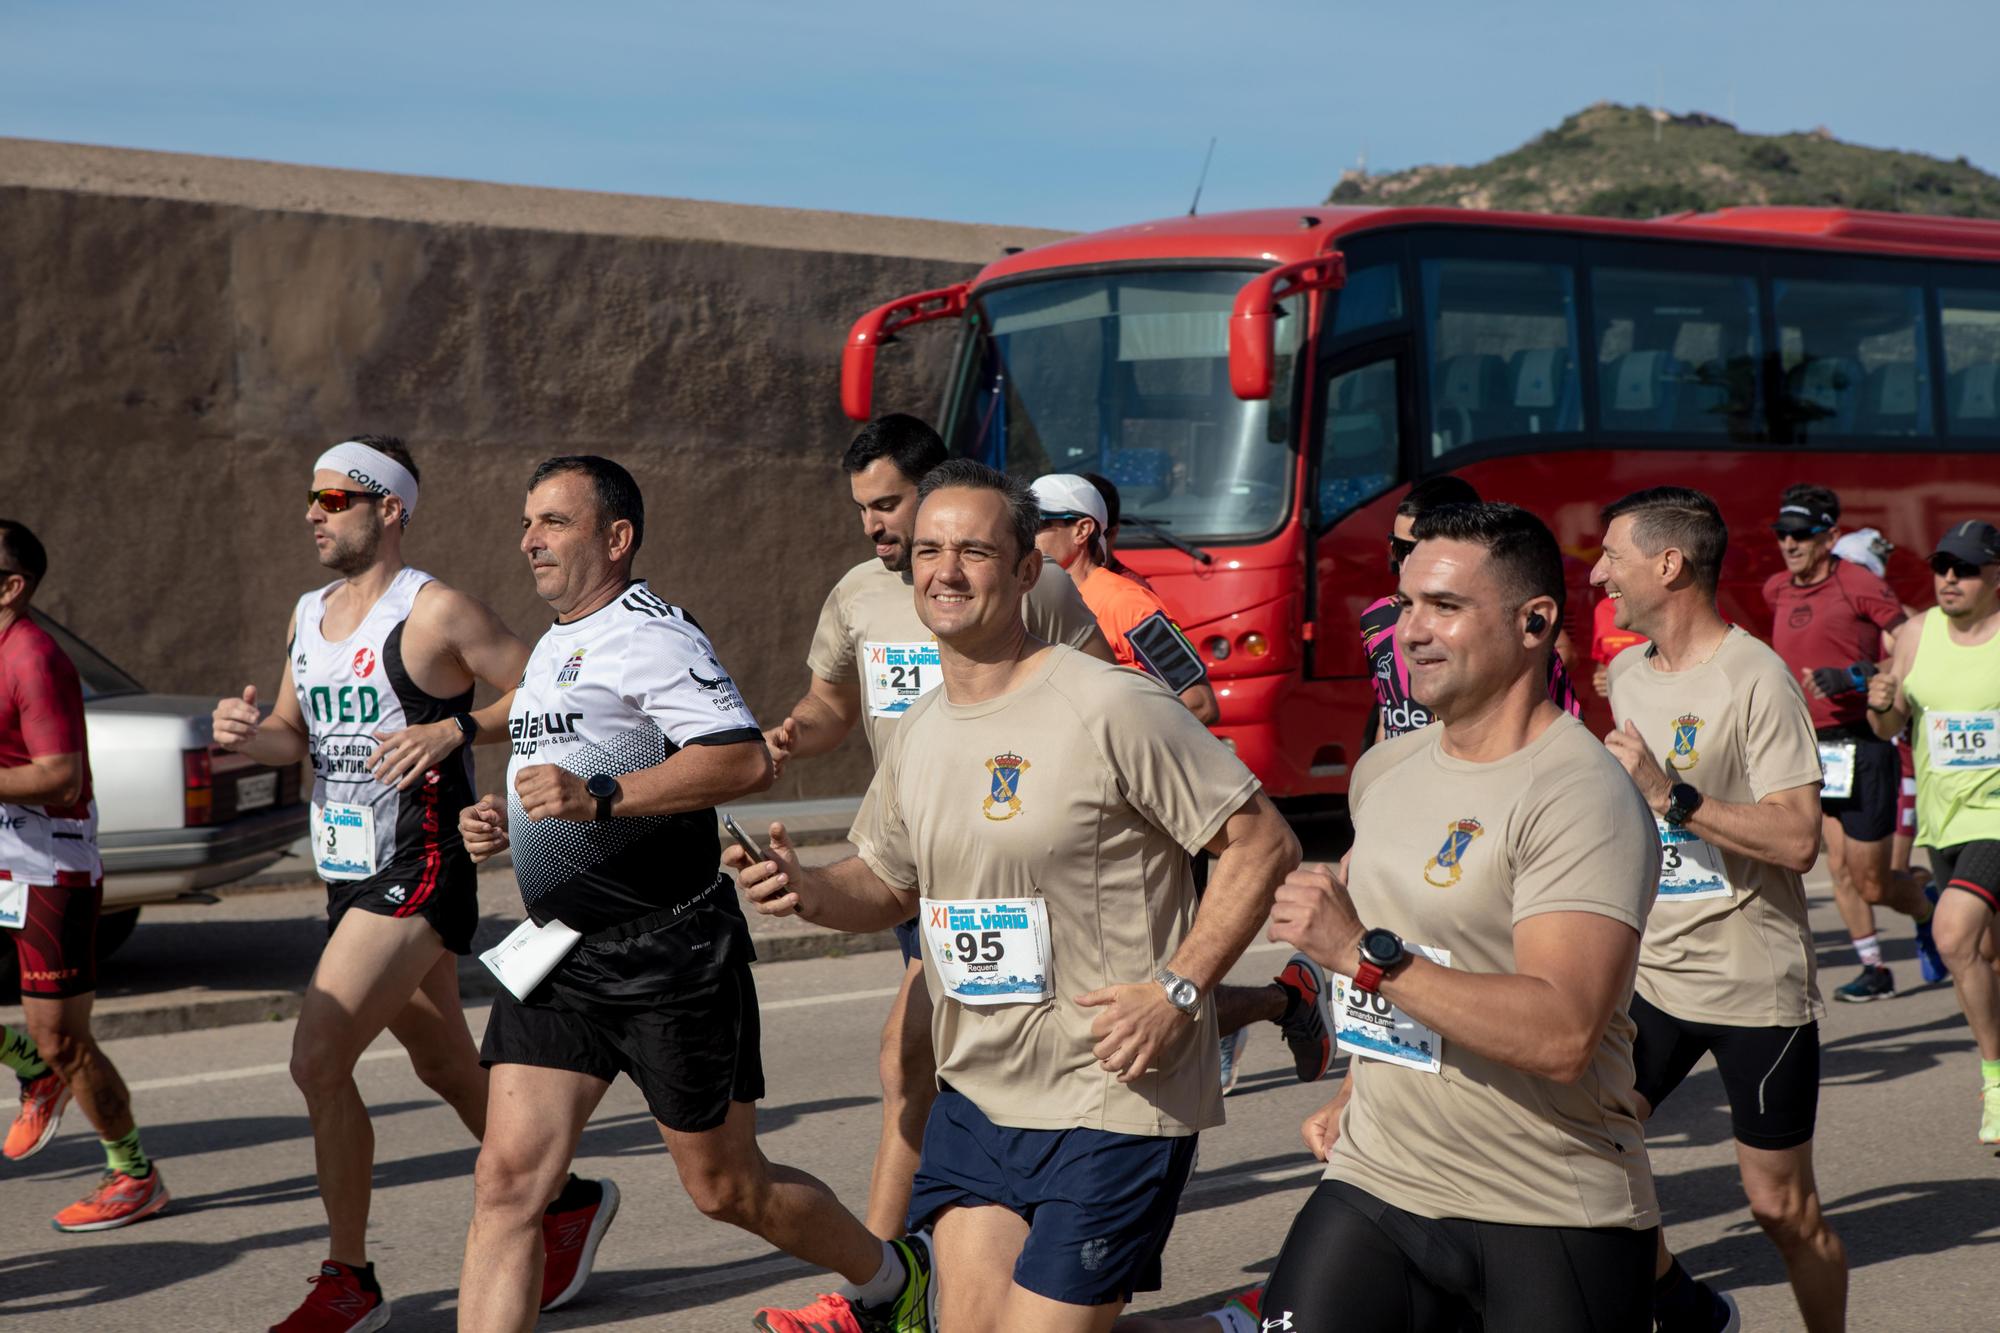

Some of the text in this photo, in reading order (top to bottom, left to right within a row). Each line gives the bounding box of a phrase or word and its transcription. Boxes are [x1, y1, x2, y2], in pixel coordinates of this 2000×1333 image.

[871, 648, 886, 664] XI
[890, 666, 921, 688] 21
[1944, 732, 1986, 749] 116
[326, 825, 338, 848] 3
[931, 906, 948, 929] XI
[948, 914, 1029, 931] CALVARIO
[955, 931, 1005, 963] 95
